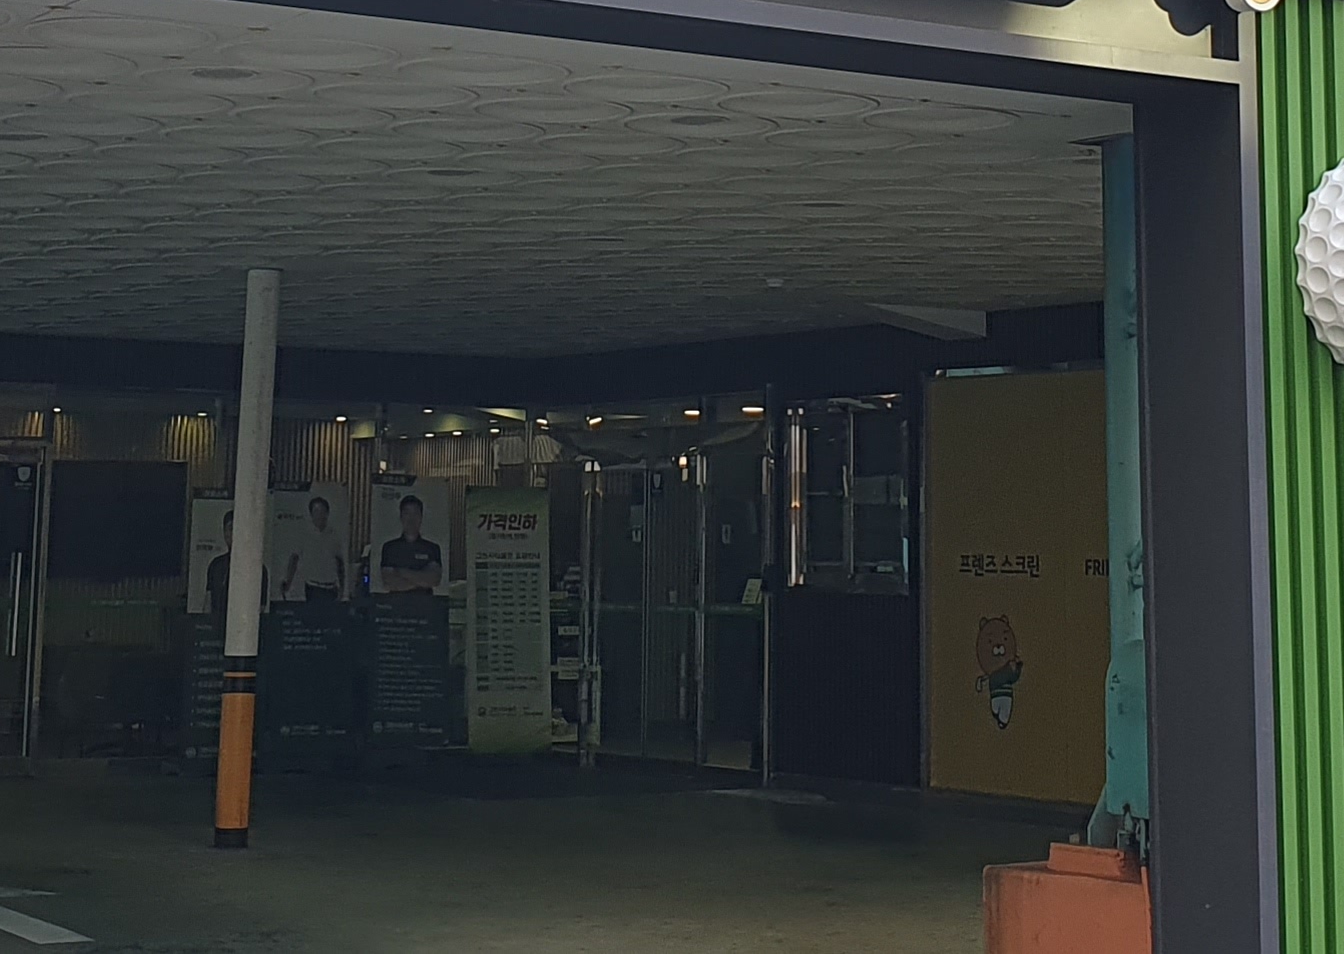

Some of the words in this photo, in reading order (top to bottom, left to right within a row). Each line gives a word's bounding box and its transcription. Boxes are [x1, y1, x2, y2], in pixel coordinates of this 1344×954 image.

[477, 512, 539, 532] 가격인하
[959, 554, 998, 577] 프렌즈
[1000, 554, 1040, 578] 스크린
